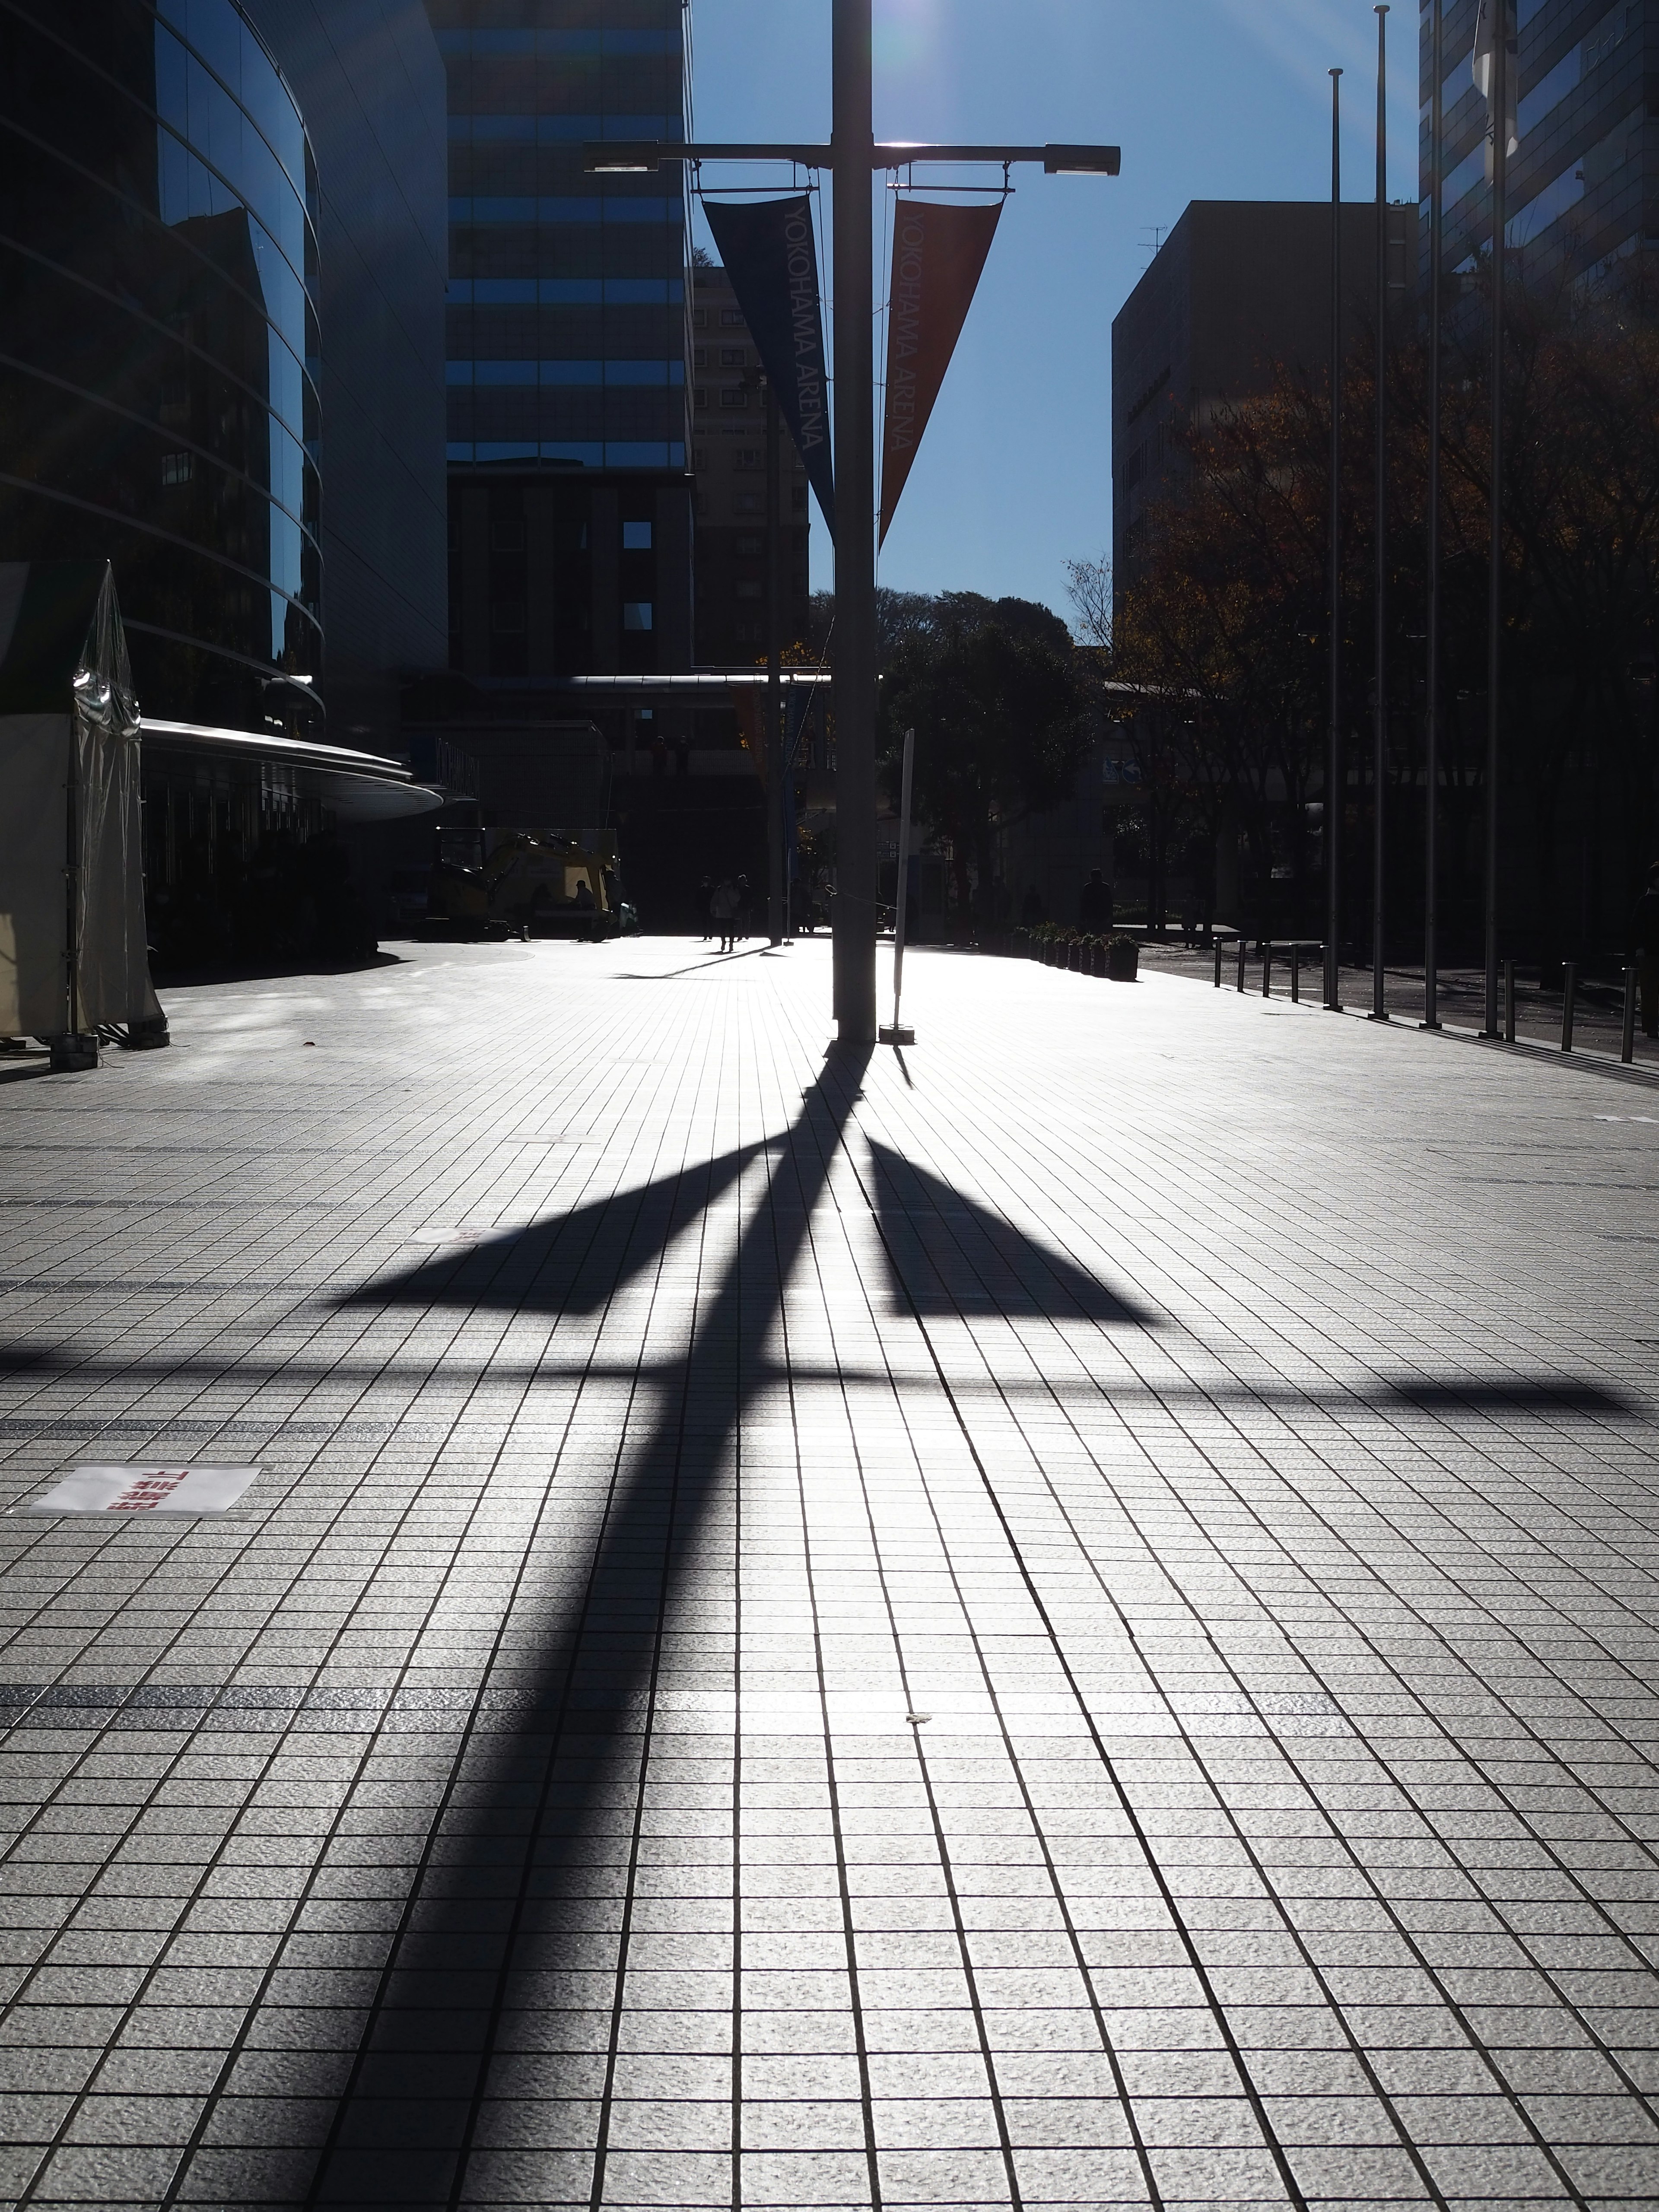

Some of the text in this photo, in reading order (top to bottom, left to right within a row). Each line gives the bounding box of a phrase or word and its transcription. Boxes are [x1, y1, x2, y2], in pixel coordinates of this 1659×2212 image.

[784, 205, 823, 451] YOKOHAMA ARENA
[890, 212, 924, 452] YOKOHAMA ARENA
[106, 1471, 189, 1511] 駐輪禁止
